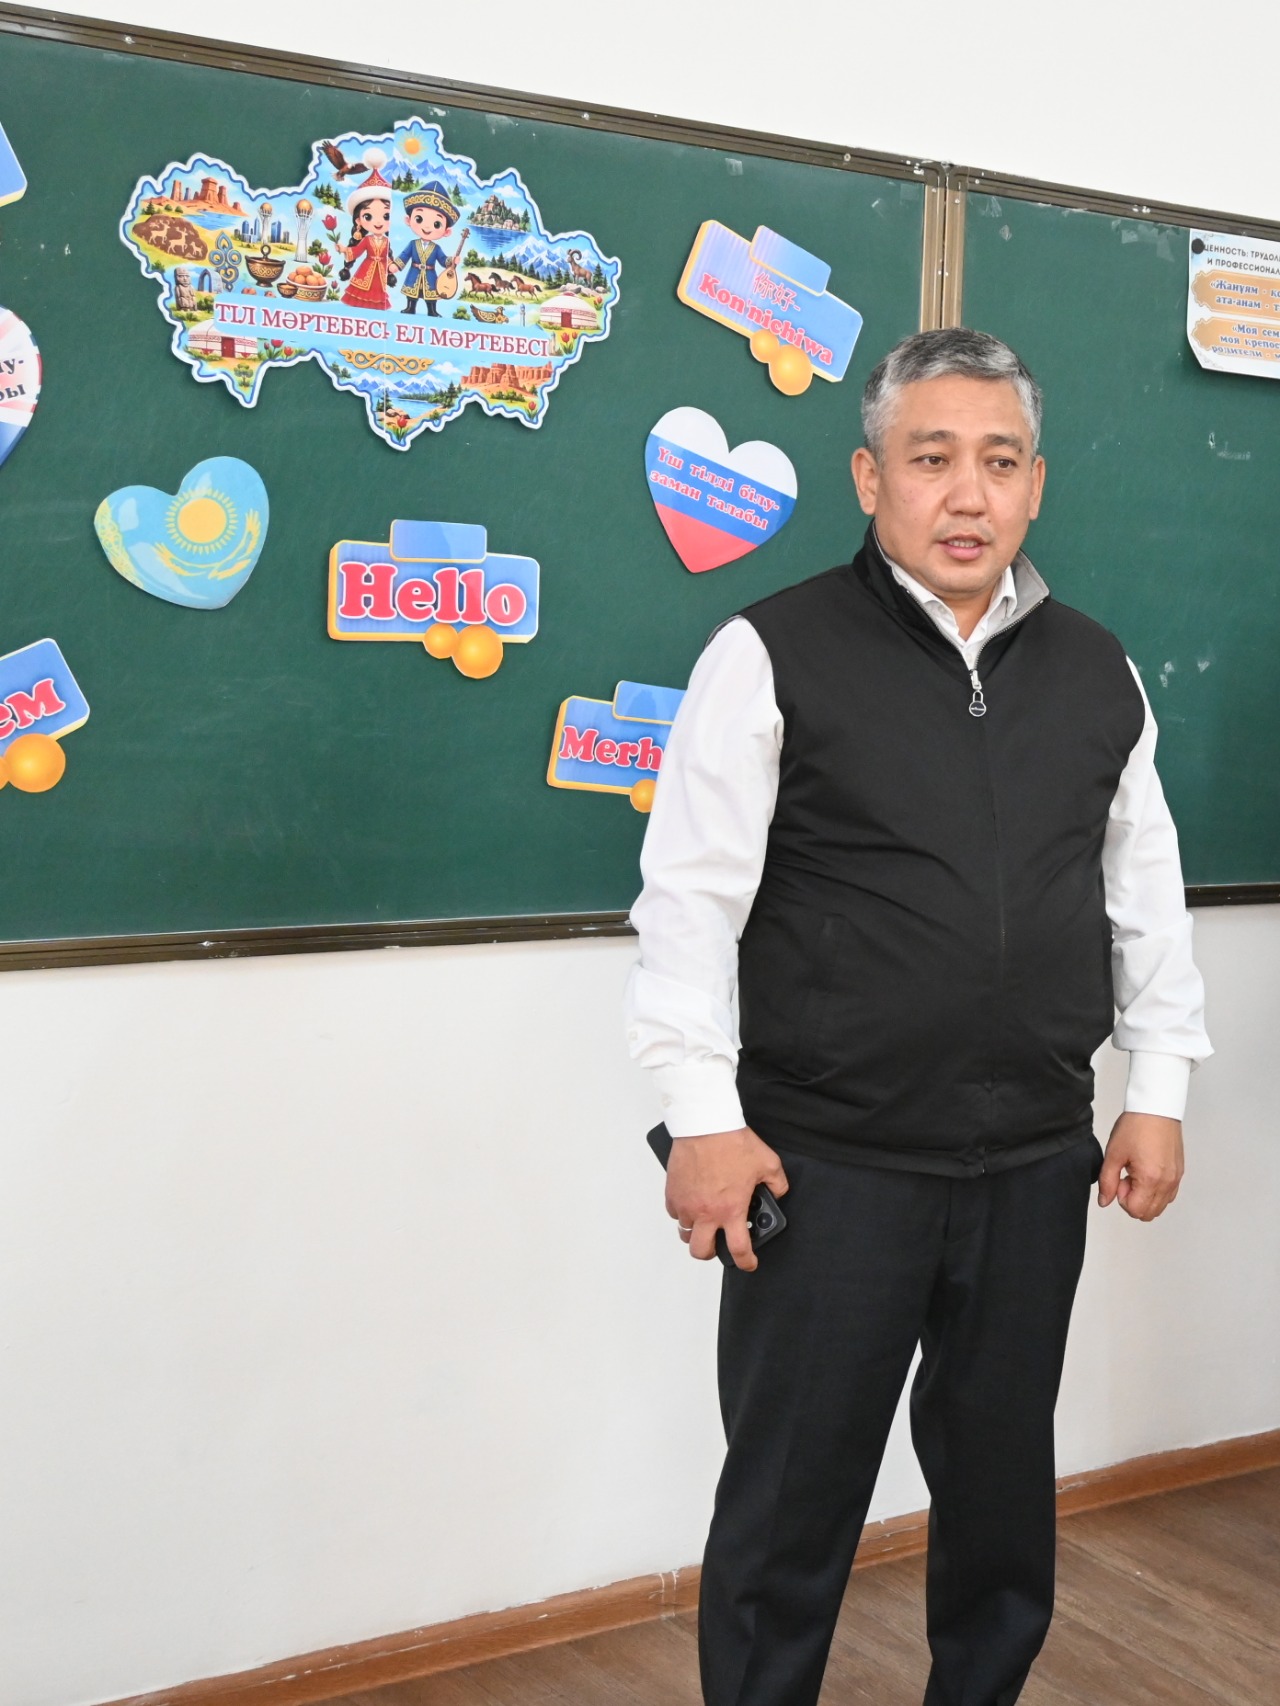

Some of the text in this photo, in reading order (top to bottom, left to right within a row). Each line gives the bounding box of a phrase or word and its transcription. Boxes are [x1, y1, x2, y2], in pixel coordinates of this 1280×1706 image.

[697, 272, 835, 366] Kon'nichiwa
[1216, 295, 1261, 308] ата-анам
[1232, 324, 1258, 335] «Моя
[215, 302, 256, 326] ТІЛ
[395, 324, 425, 345] ЕЛ
[429, 327, 550, 358] МӘРТЕБЕСІ
[1220, 335, 1240, 344] моя
[649, 470, 769, 531] заман талабы
[658, 447, 780, 513] Үш тілді білу-
[338, 561, 527, 627] Hello
[558, 725, 664, 772] Merh
